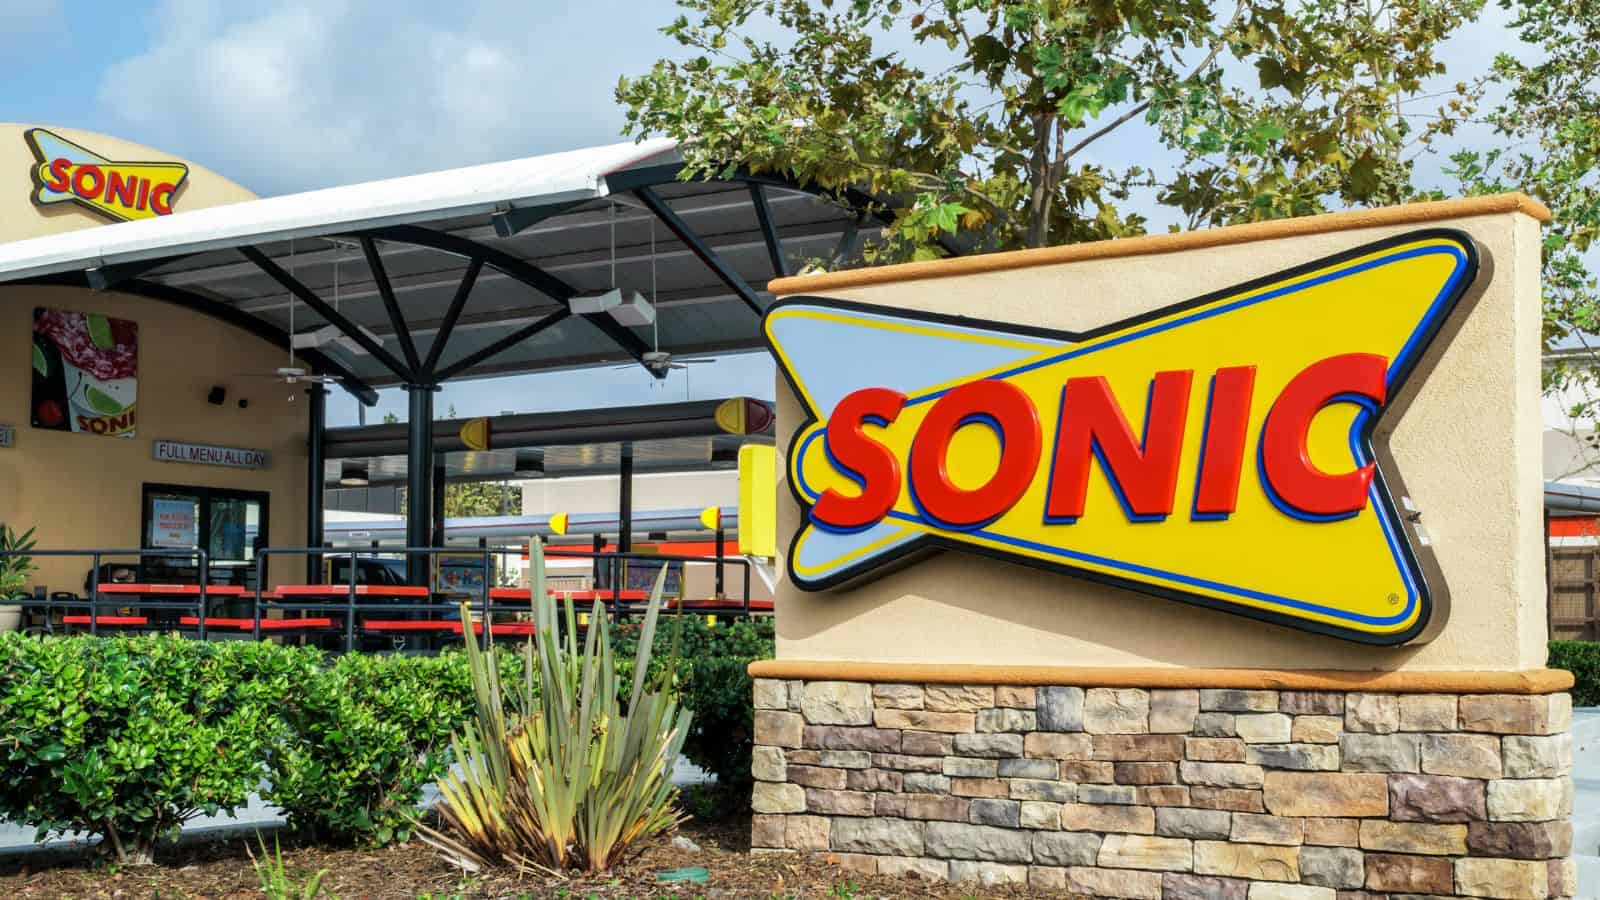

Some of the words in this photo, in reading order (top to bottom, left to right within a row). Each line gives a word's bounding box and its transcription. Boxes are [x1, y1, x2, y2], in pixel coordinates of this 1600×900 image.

[46, 158, 176, 216] SONIC
[159, 443, 189, 459] FULL
[190, 446, 223, 462] MENU
[224, 449, 244, 465] ALL
[245, 451, 266, 466] DAY
[810, 353, 1388, 533] SONIC
